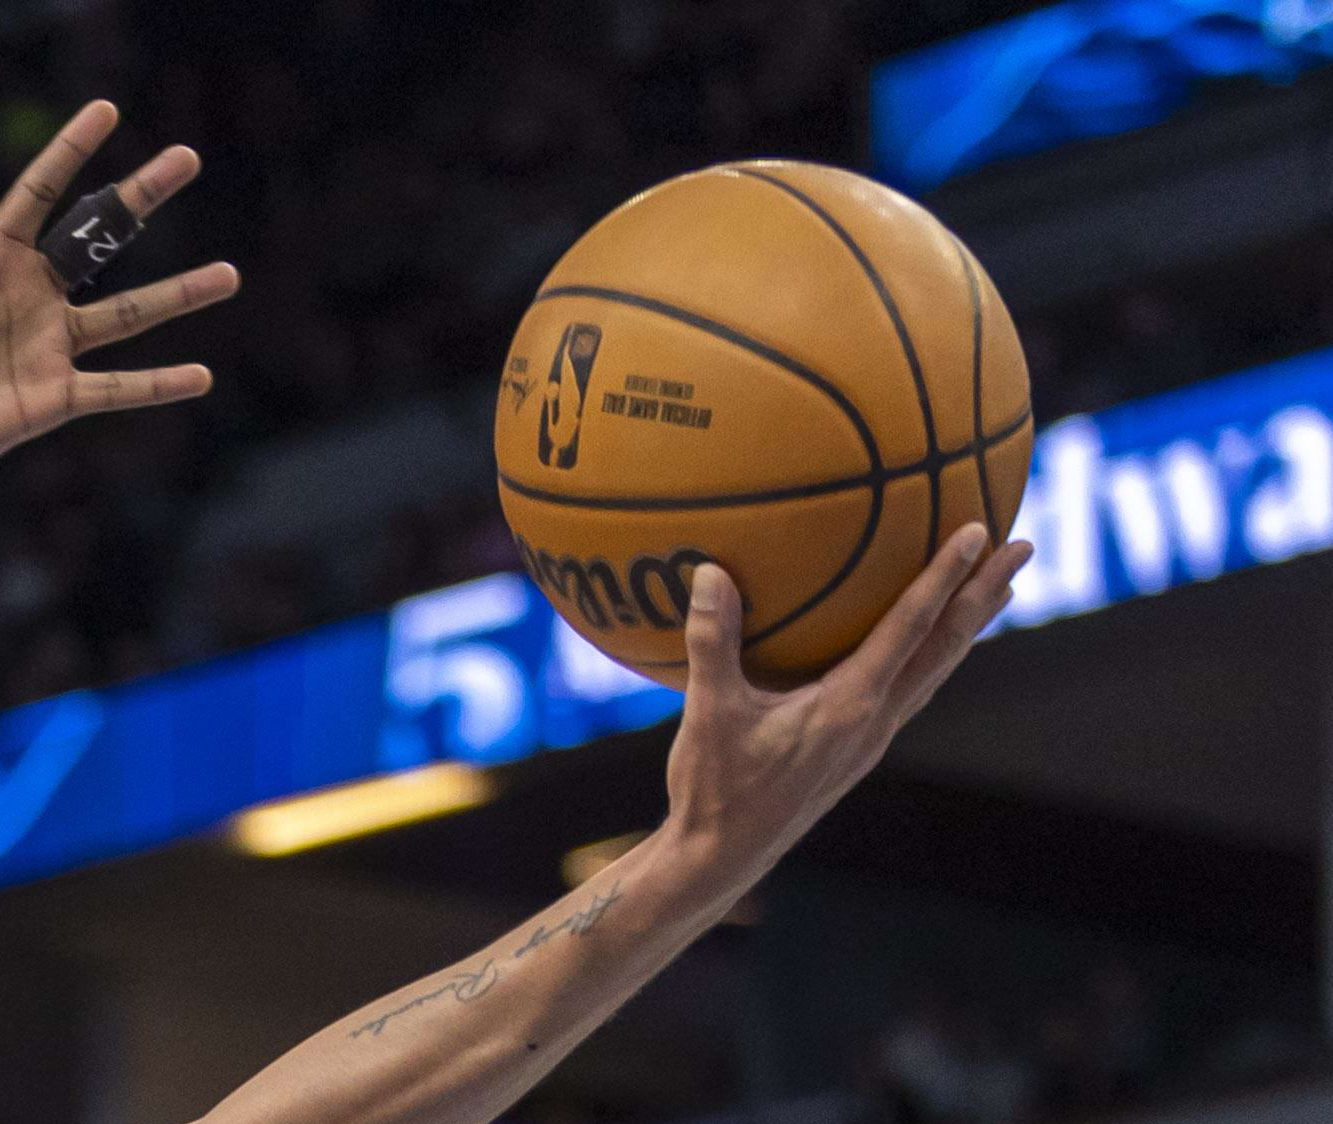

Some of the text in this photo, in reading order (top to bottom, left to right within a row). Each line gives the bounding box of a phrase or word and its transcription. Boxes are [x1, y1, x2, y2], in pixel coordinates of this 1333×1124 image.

[70, 216, 120, 263] 21
[387, 572, 530, 752] 5
[994, 405, 1333, 630] dwa
